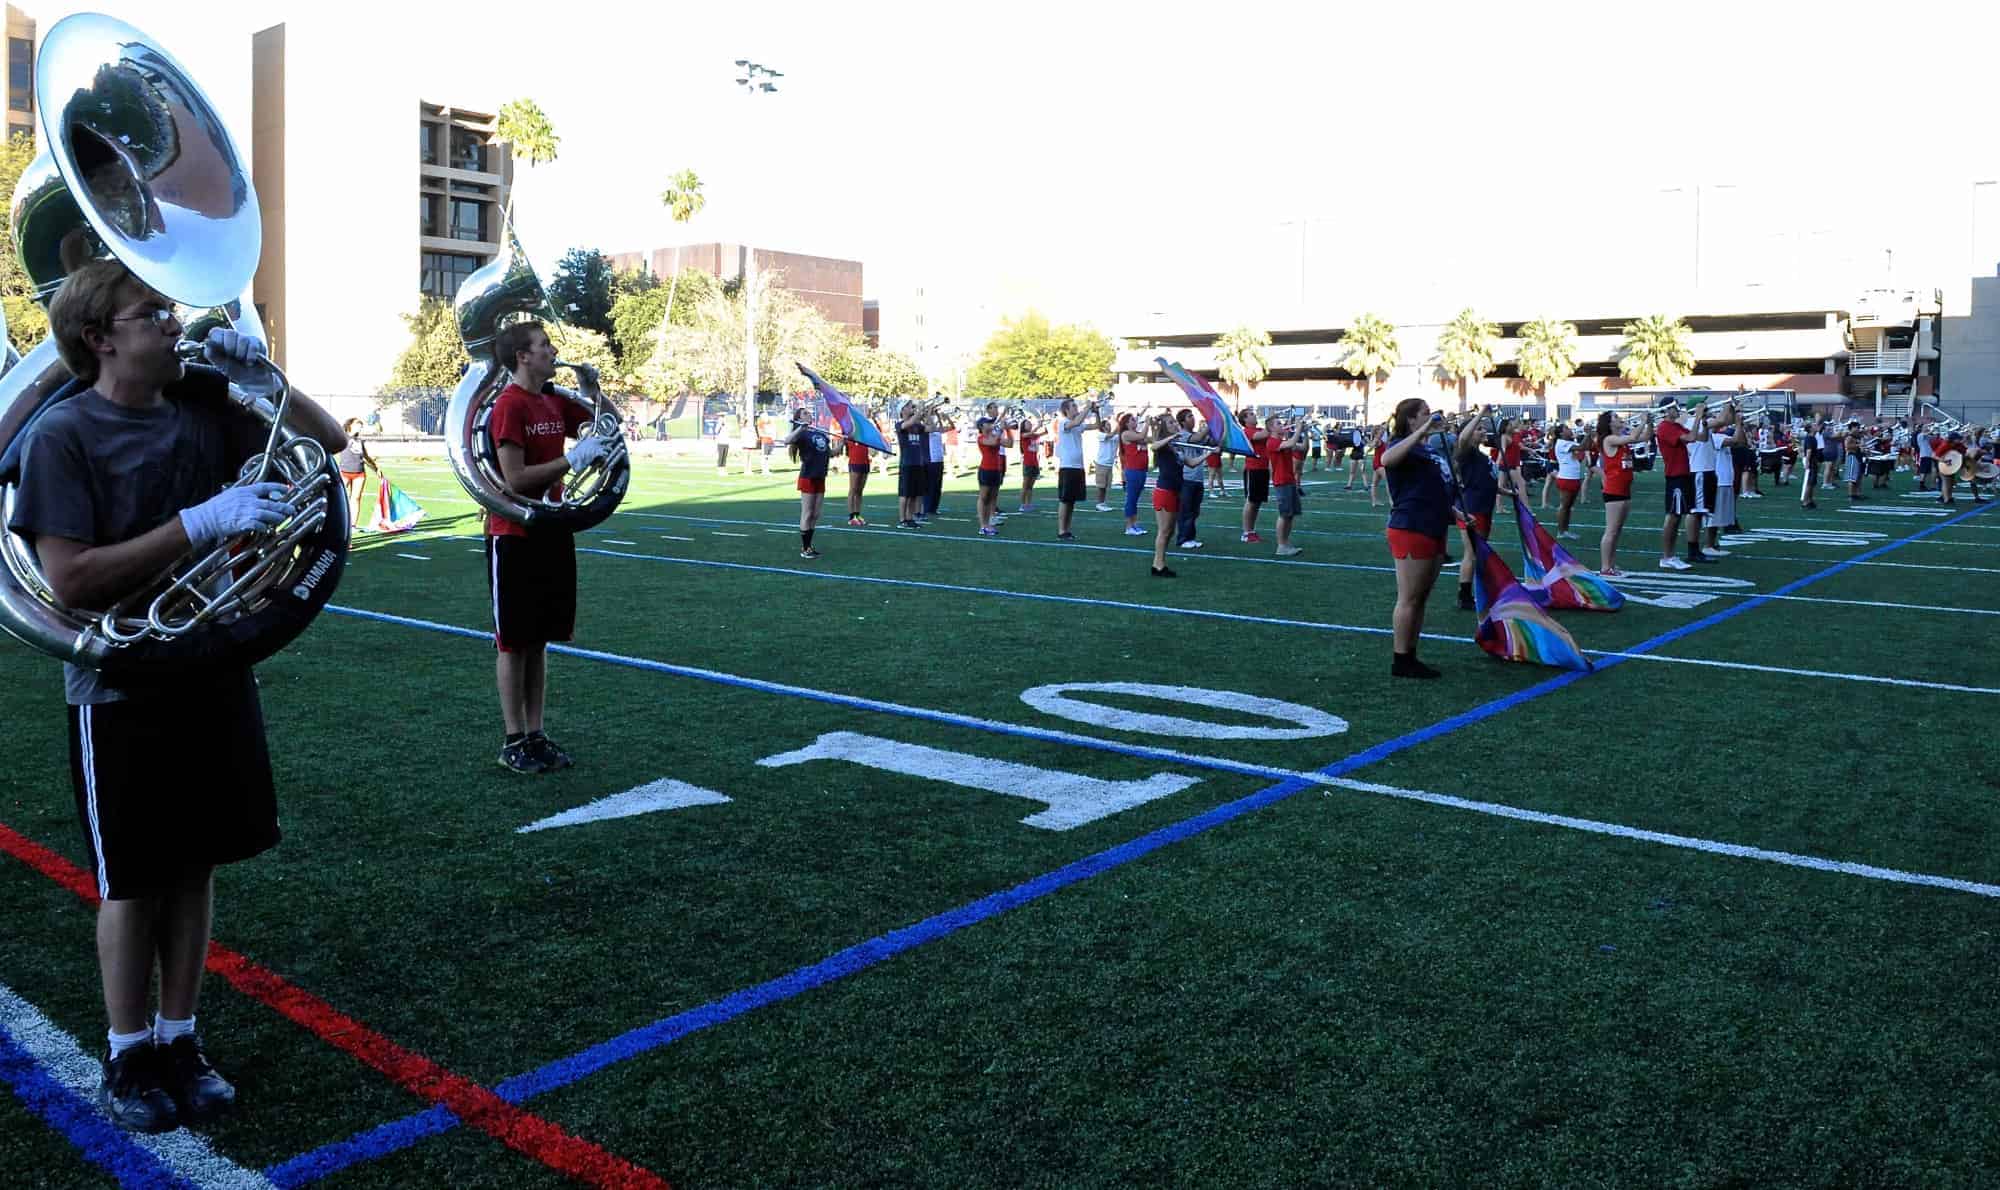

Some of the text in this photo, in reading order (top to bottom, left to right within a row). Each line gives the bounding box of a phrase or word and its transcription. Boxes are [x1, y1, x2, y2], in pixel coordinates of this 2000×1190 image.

[1720, 528, 1889, 546] 30
[301, 548, 337, 589] YAMAHA
[755, 681, 1350, 832] 10
